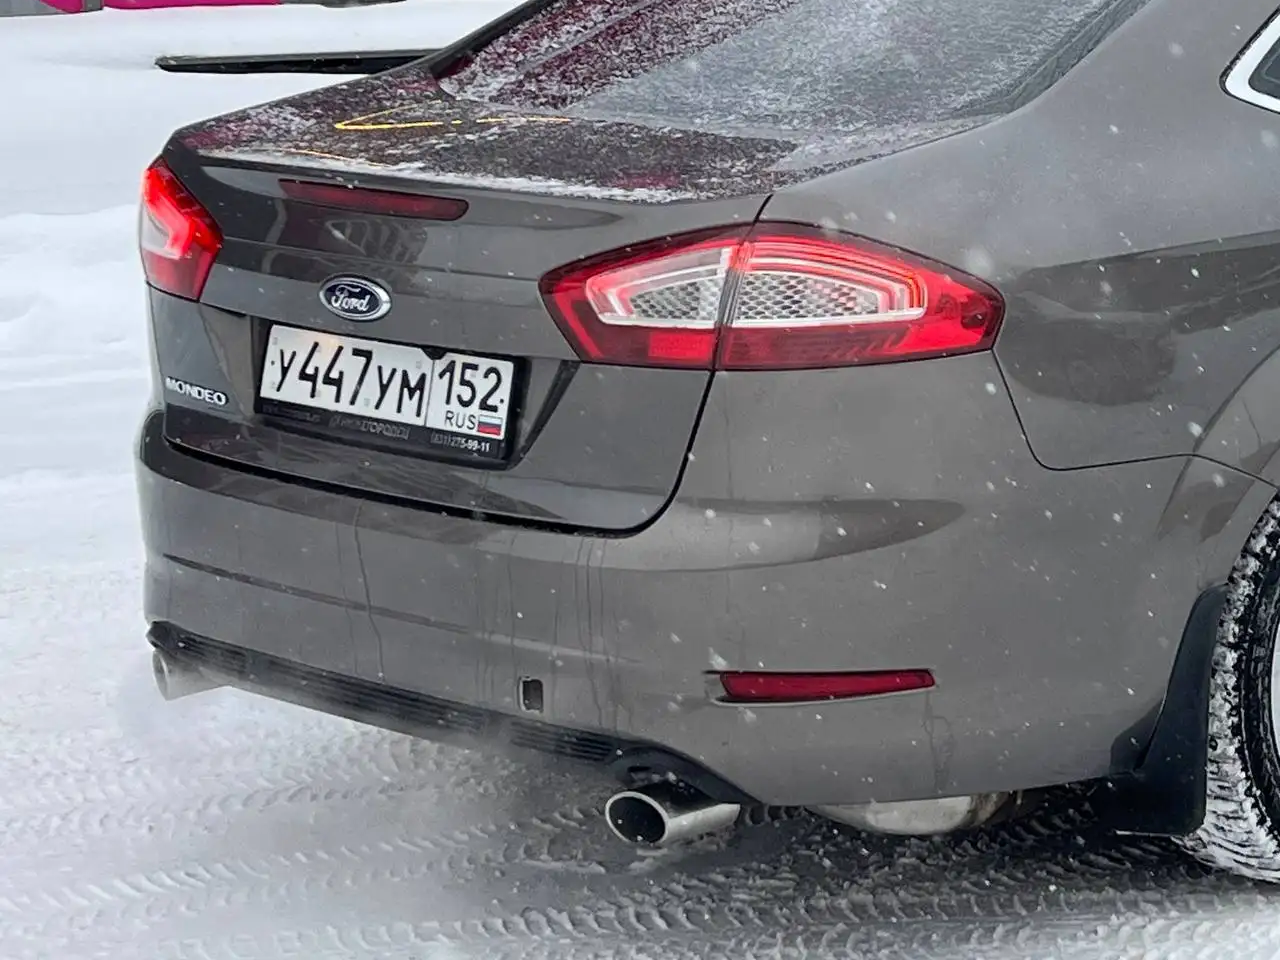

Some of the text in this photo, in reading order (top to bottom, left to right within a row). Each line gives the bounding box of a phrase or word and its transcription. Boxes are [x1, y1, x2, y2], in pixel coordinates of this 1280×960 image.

[331, 284, 371, 311] Ford
[165, 377, 227, 406] MONDEO
[438, 360, 502, 413] 152
[444, 410, 477, 430] RUS
